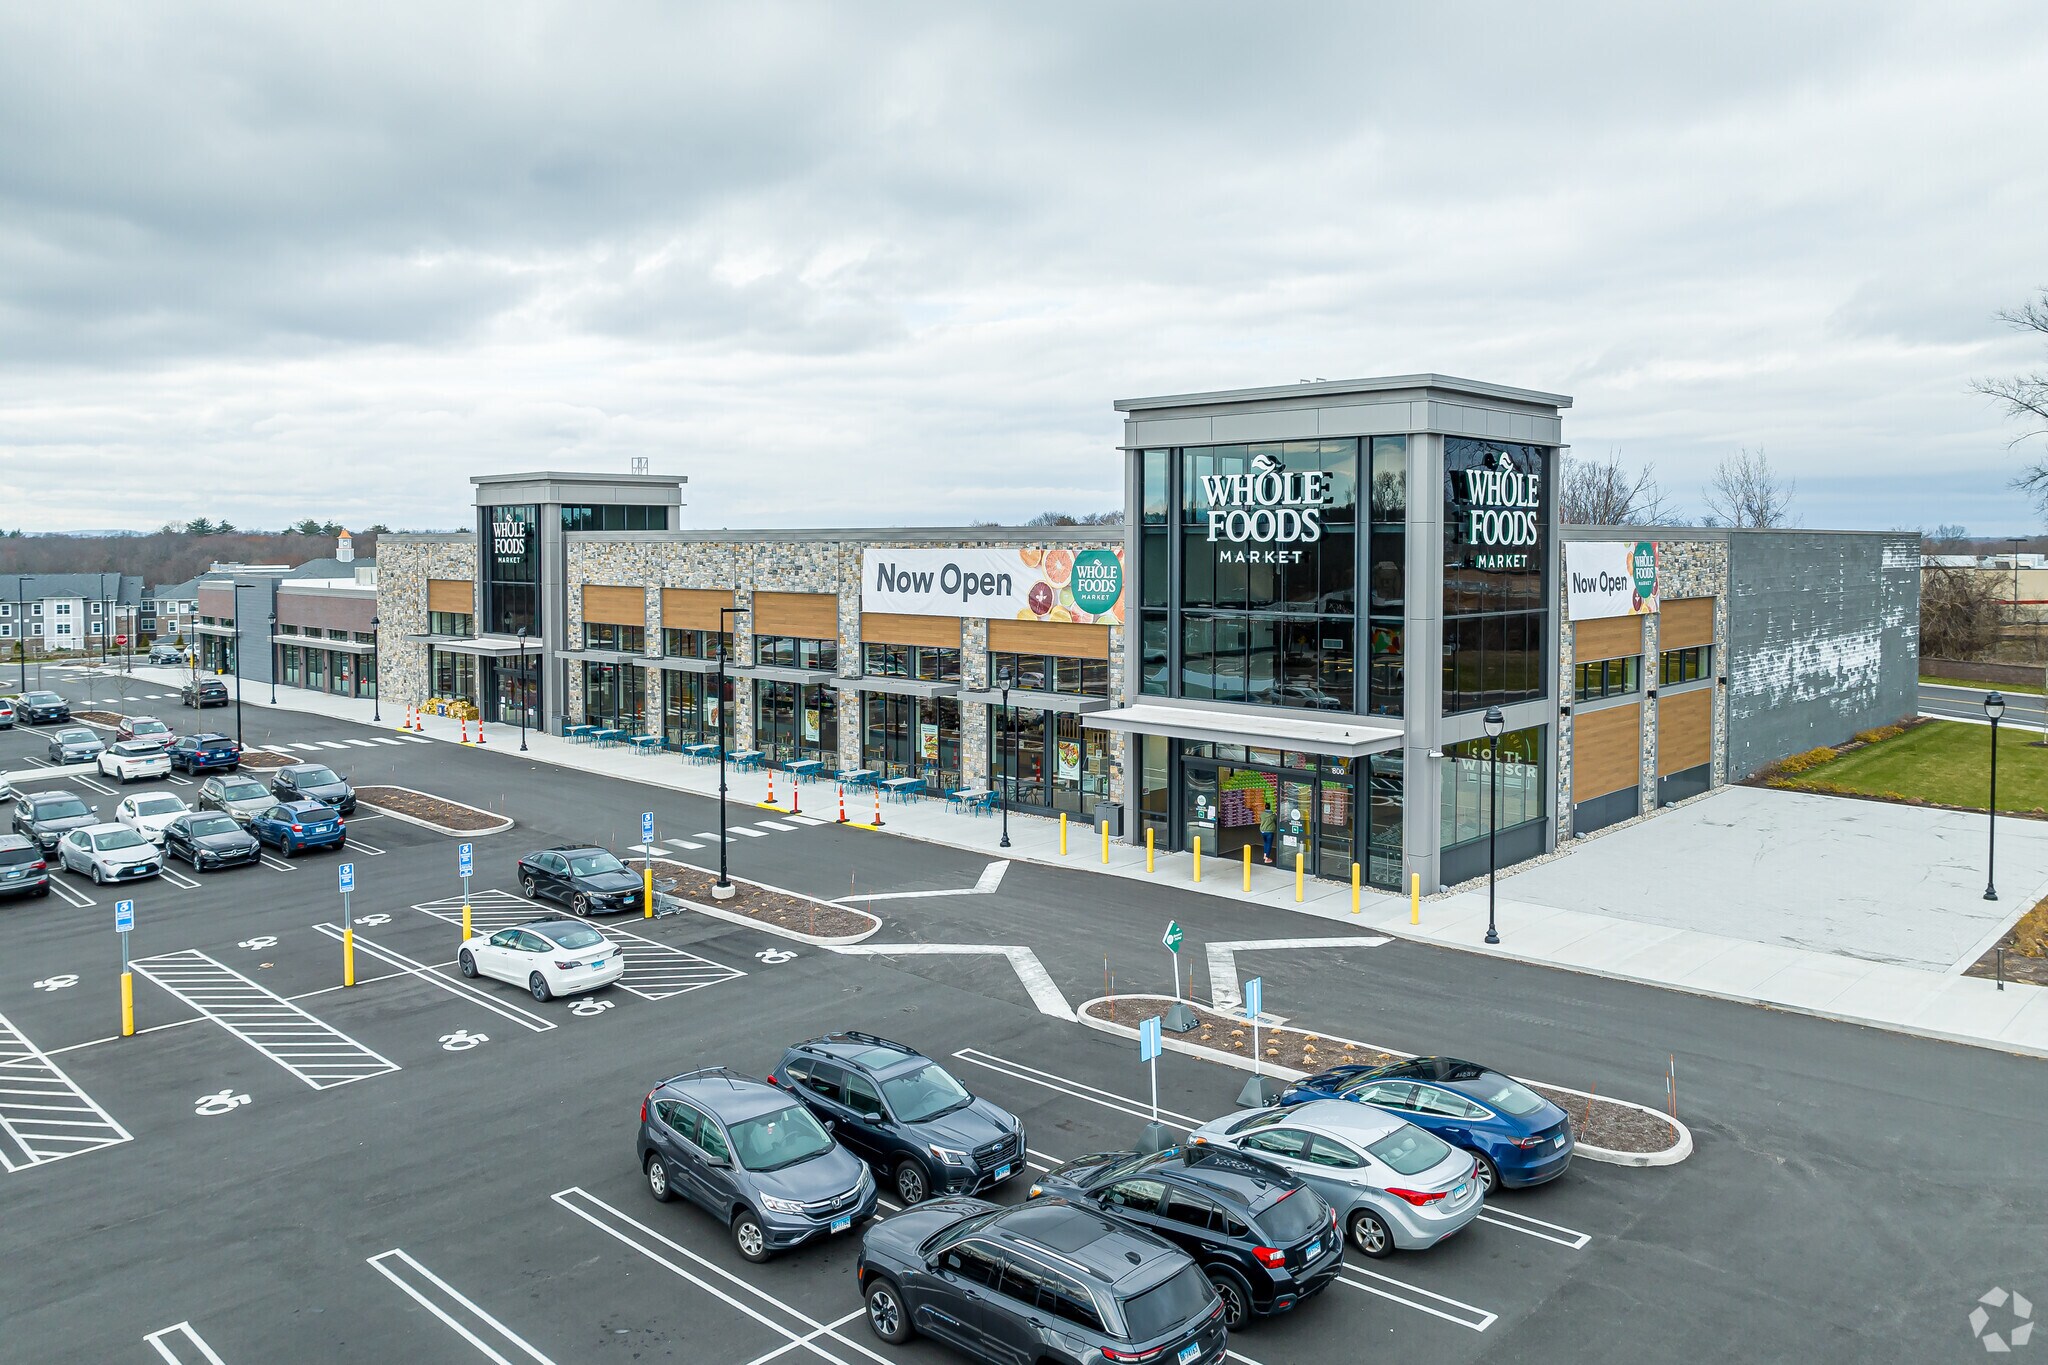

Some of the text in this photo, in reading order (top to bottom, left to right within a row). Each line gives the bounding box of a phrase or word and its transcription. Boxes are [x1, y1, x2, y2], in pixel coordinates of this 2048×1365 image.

[1200, 471, 1324, 507] WHOLE
[1466, 468, 1539, 507] WHOLE
[492, 521, 525, 538] WHOLE
[1206, 508, 1321, 543] FOODS
[1470, 509, 1537, 545] FOODS
[494, 538, 525, 554] FOODS
[497, 556, 520, 564] MARKET
[1219, 550, 1302, 564] MARKET
[1478, 554, 1528, 568] MARKET
[1634, 555, 1655, 567] WHOLE
[1076, 564, 1118, 579] WHOLE
[1635, 567, 1655, 580] FOODS
[876, 562, 1012, 603] Now Open
[1077, 579, 1117, 593] FOODS
[1572, 570, 1628, 597] Now Open
